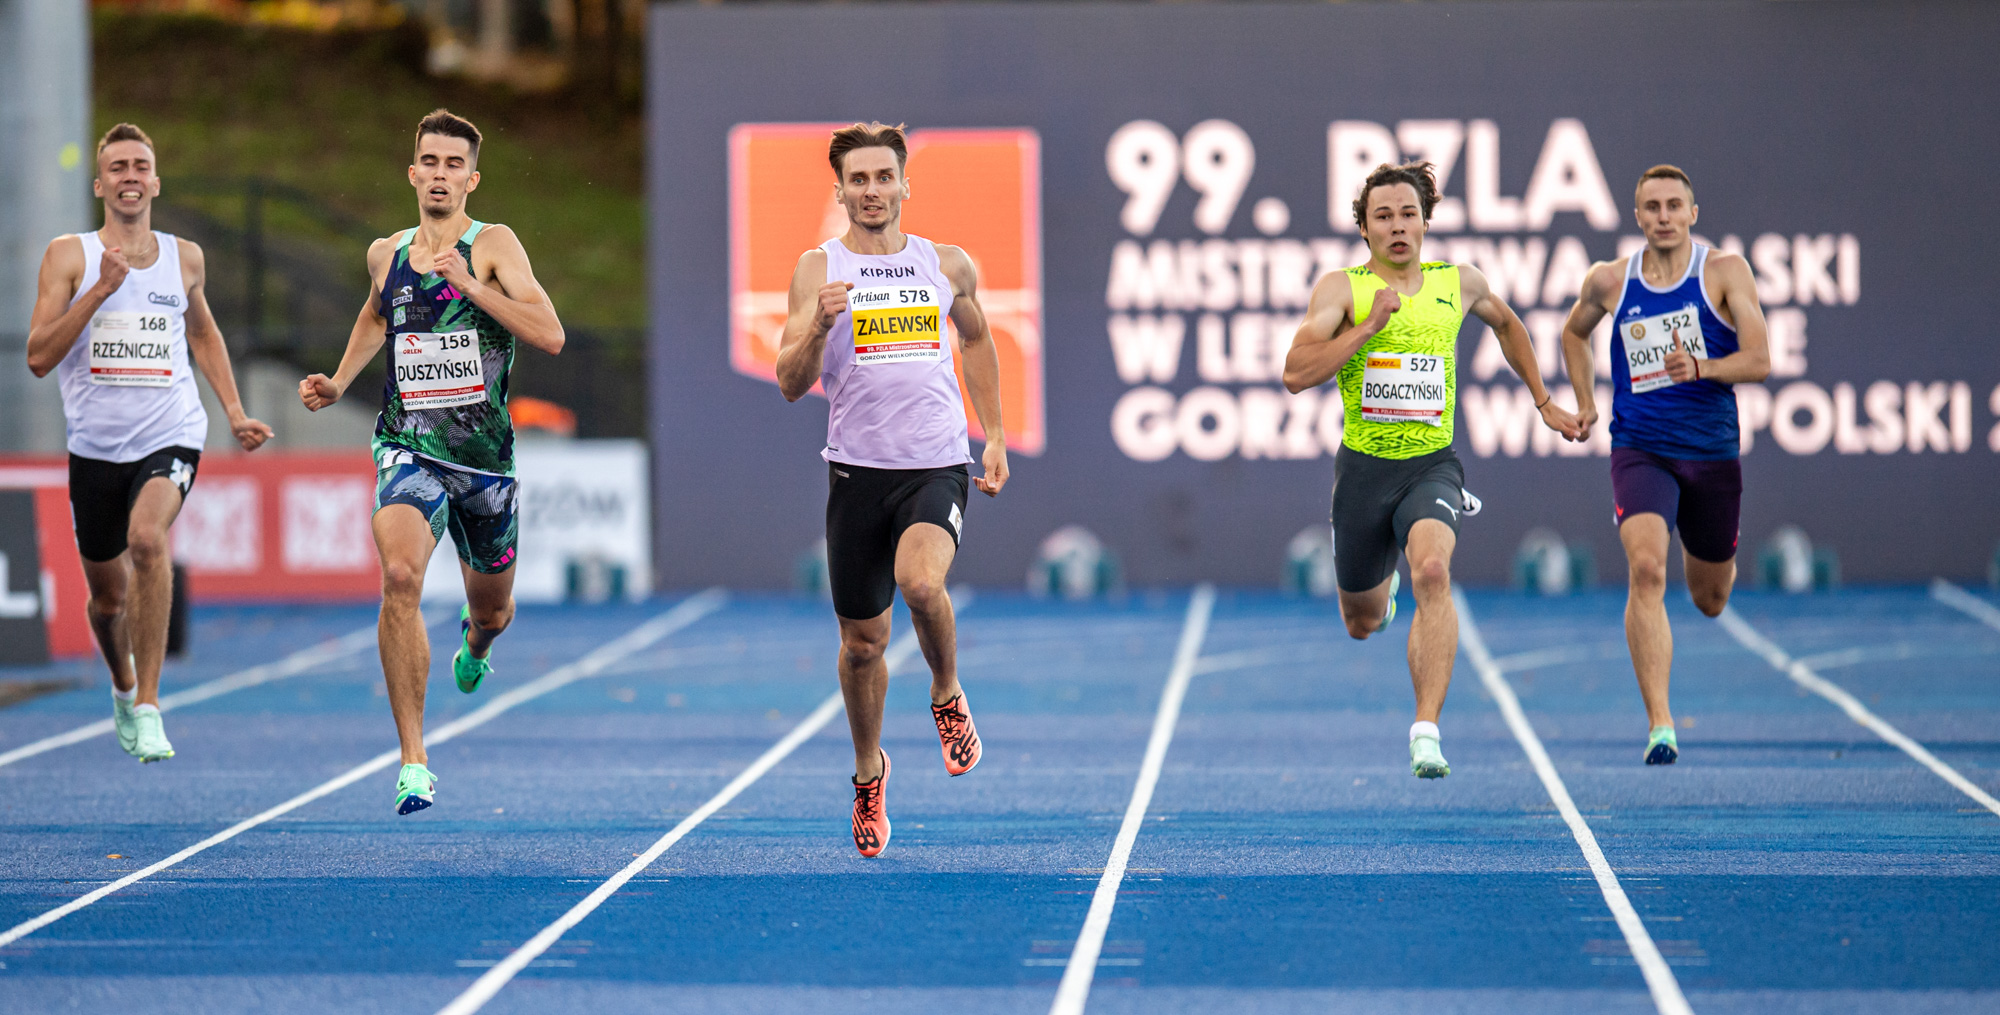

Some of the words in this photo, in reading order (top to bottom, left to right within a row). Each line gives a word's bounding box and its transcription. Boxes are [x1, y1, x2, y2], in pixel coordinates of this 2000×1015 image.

[1105, 118, 1291, 236] 99.
[1326, 117, 1620, 234] PZLA
[860, 266, 915, 278] KIPRUN
[852, 291, 890, 304] Artisan
[899, 290, 930, 303] 578
[139, 317, 167, 331] 168
[857, 315, 937, 336] ZALEWSKI
[1663, 314, 1691, 332] 552
[93, 339, 170, 360] RZEŹNICZAK
[439, 334, 470, 350] 158
[1107, 313, 1188, 383] W
[888, 351, 928, 359] WIELKOPOLSKI
[1630, 337, 1701, 367] SOŁTYSAK
[398, 359, 478, 382] DUSZYŃSKI
[1410, 358, 1437, 372] 527
[1365, 381, 1443, 400] BOGACZYŃSKI
[403, 399, 425, 407] ORZÓW
